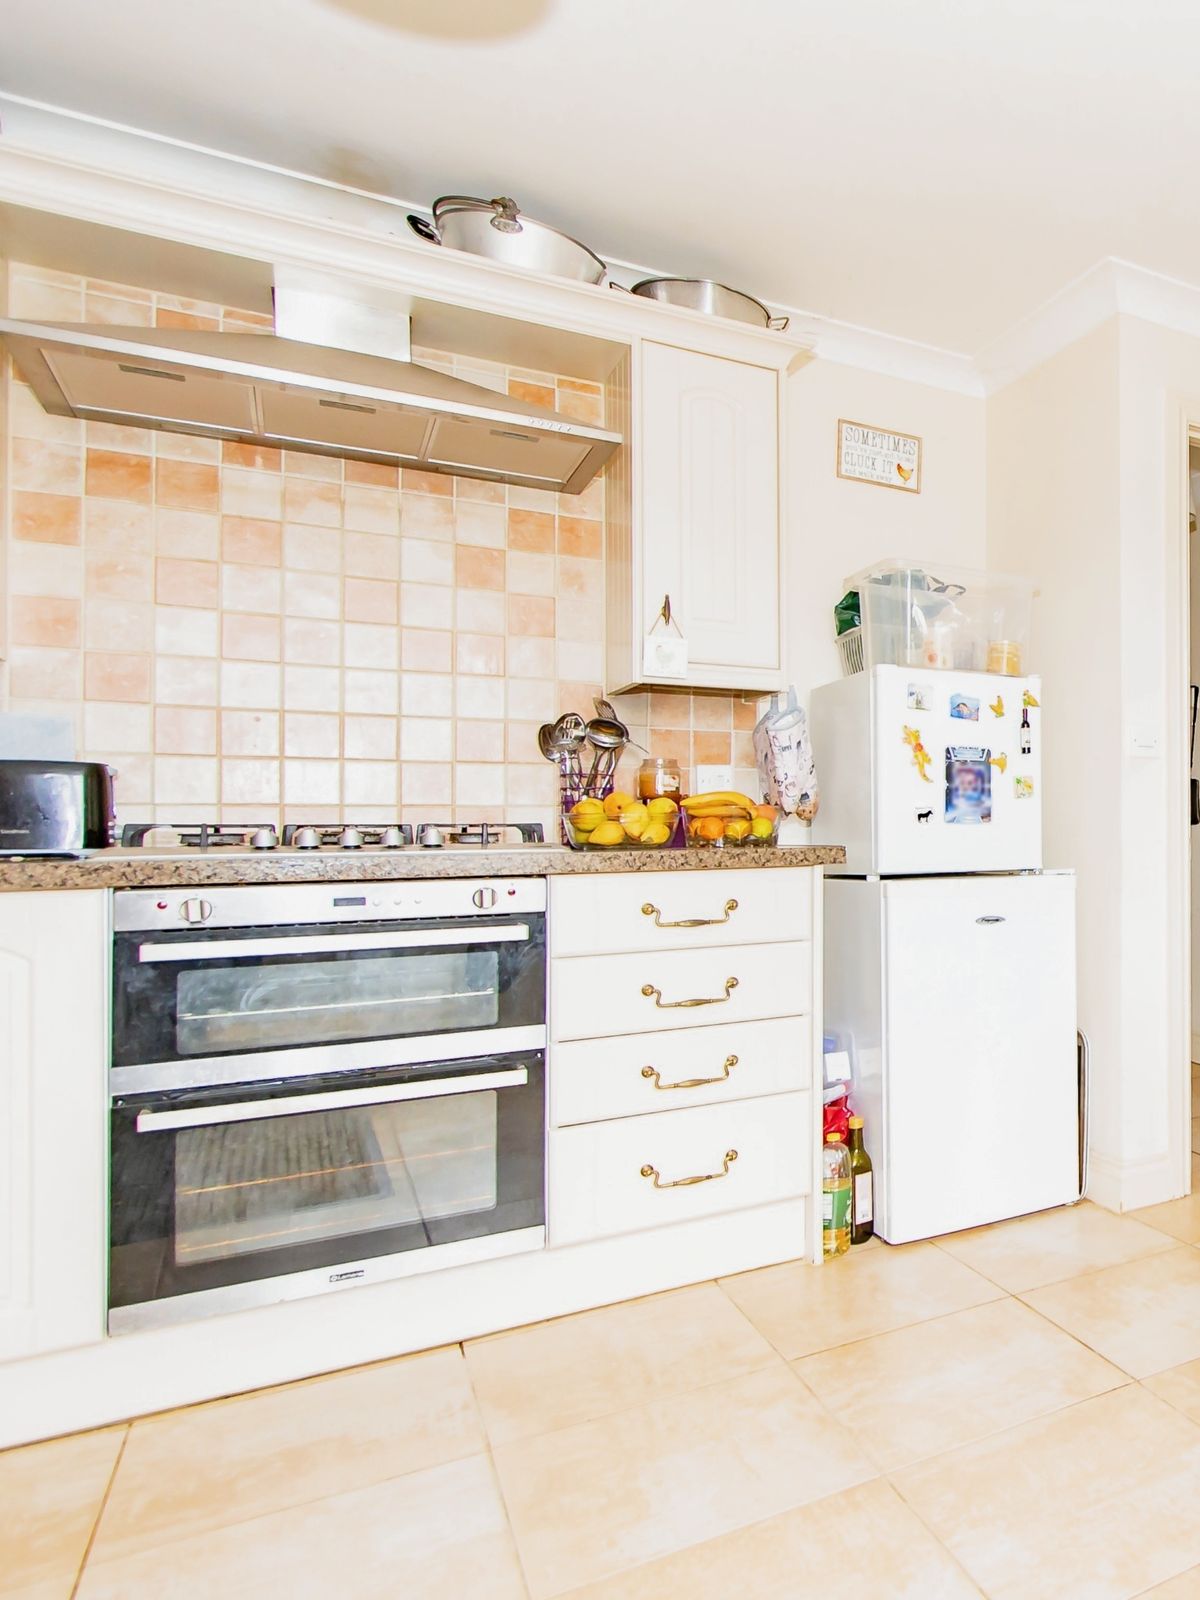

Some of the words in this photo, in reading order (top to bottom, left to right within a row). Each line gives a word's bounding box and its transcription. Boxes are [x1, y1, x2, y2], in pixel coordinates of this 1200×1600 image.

[845, 426, 916, 456] SOMETIMES
[844, 451, 876, 471] CLUCK
[882, 459, 894, 474] IT
